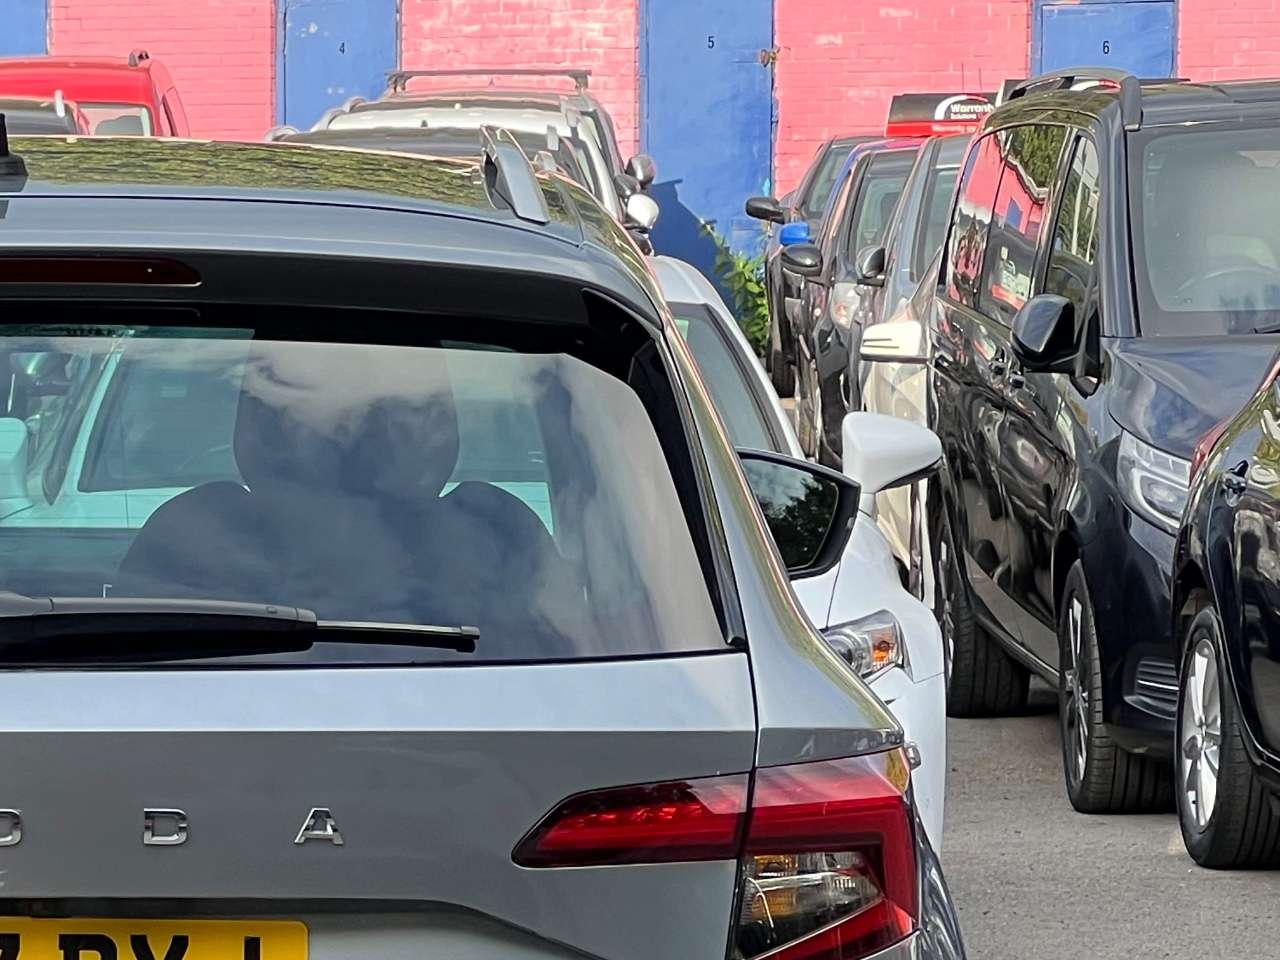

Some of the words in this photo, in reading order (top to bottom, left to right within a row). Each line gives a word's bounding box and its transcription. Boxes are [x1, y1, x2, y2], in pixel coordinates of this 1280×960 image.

[339, 41, 345, 54] 4
[707, 35, 715, 49] 5
[1102, 40, 1110, 55] 6
